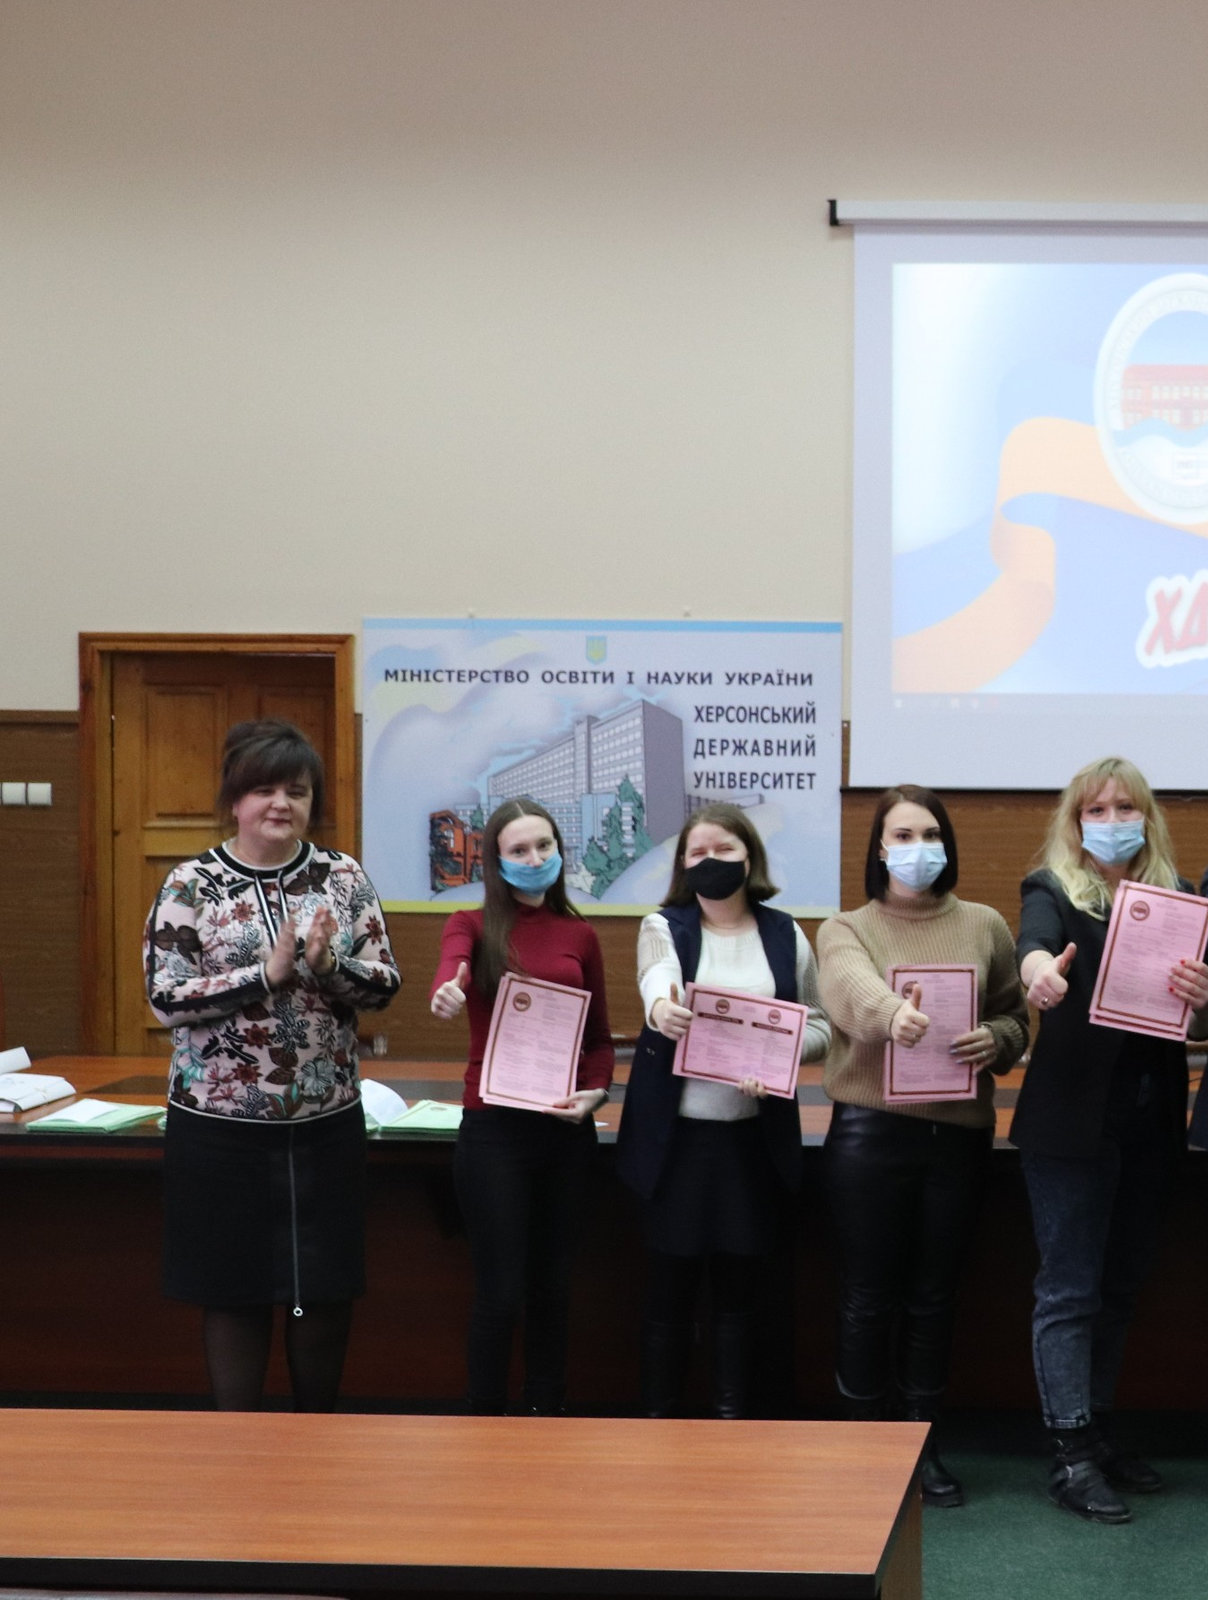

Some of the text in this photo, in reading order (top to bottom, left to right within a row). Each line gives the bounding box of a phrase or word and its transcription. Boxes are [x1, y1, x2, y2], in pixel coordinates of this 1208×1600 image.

[384, 668, 814, 687] МІНІСТЕРСТВО ОСВІТИ І НАУКИ УКРАЇНИ
[694, 701, 817, 725] ХЕРСОНСЬКИЙ
[693, 735, 817, 759] ДЕРЖАВНИЙ
[693, 771, 817, 791] УНІВЕРСИТЕТ
